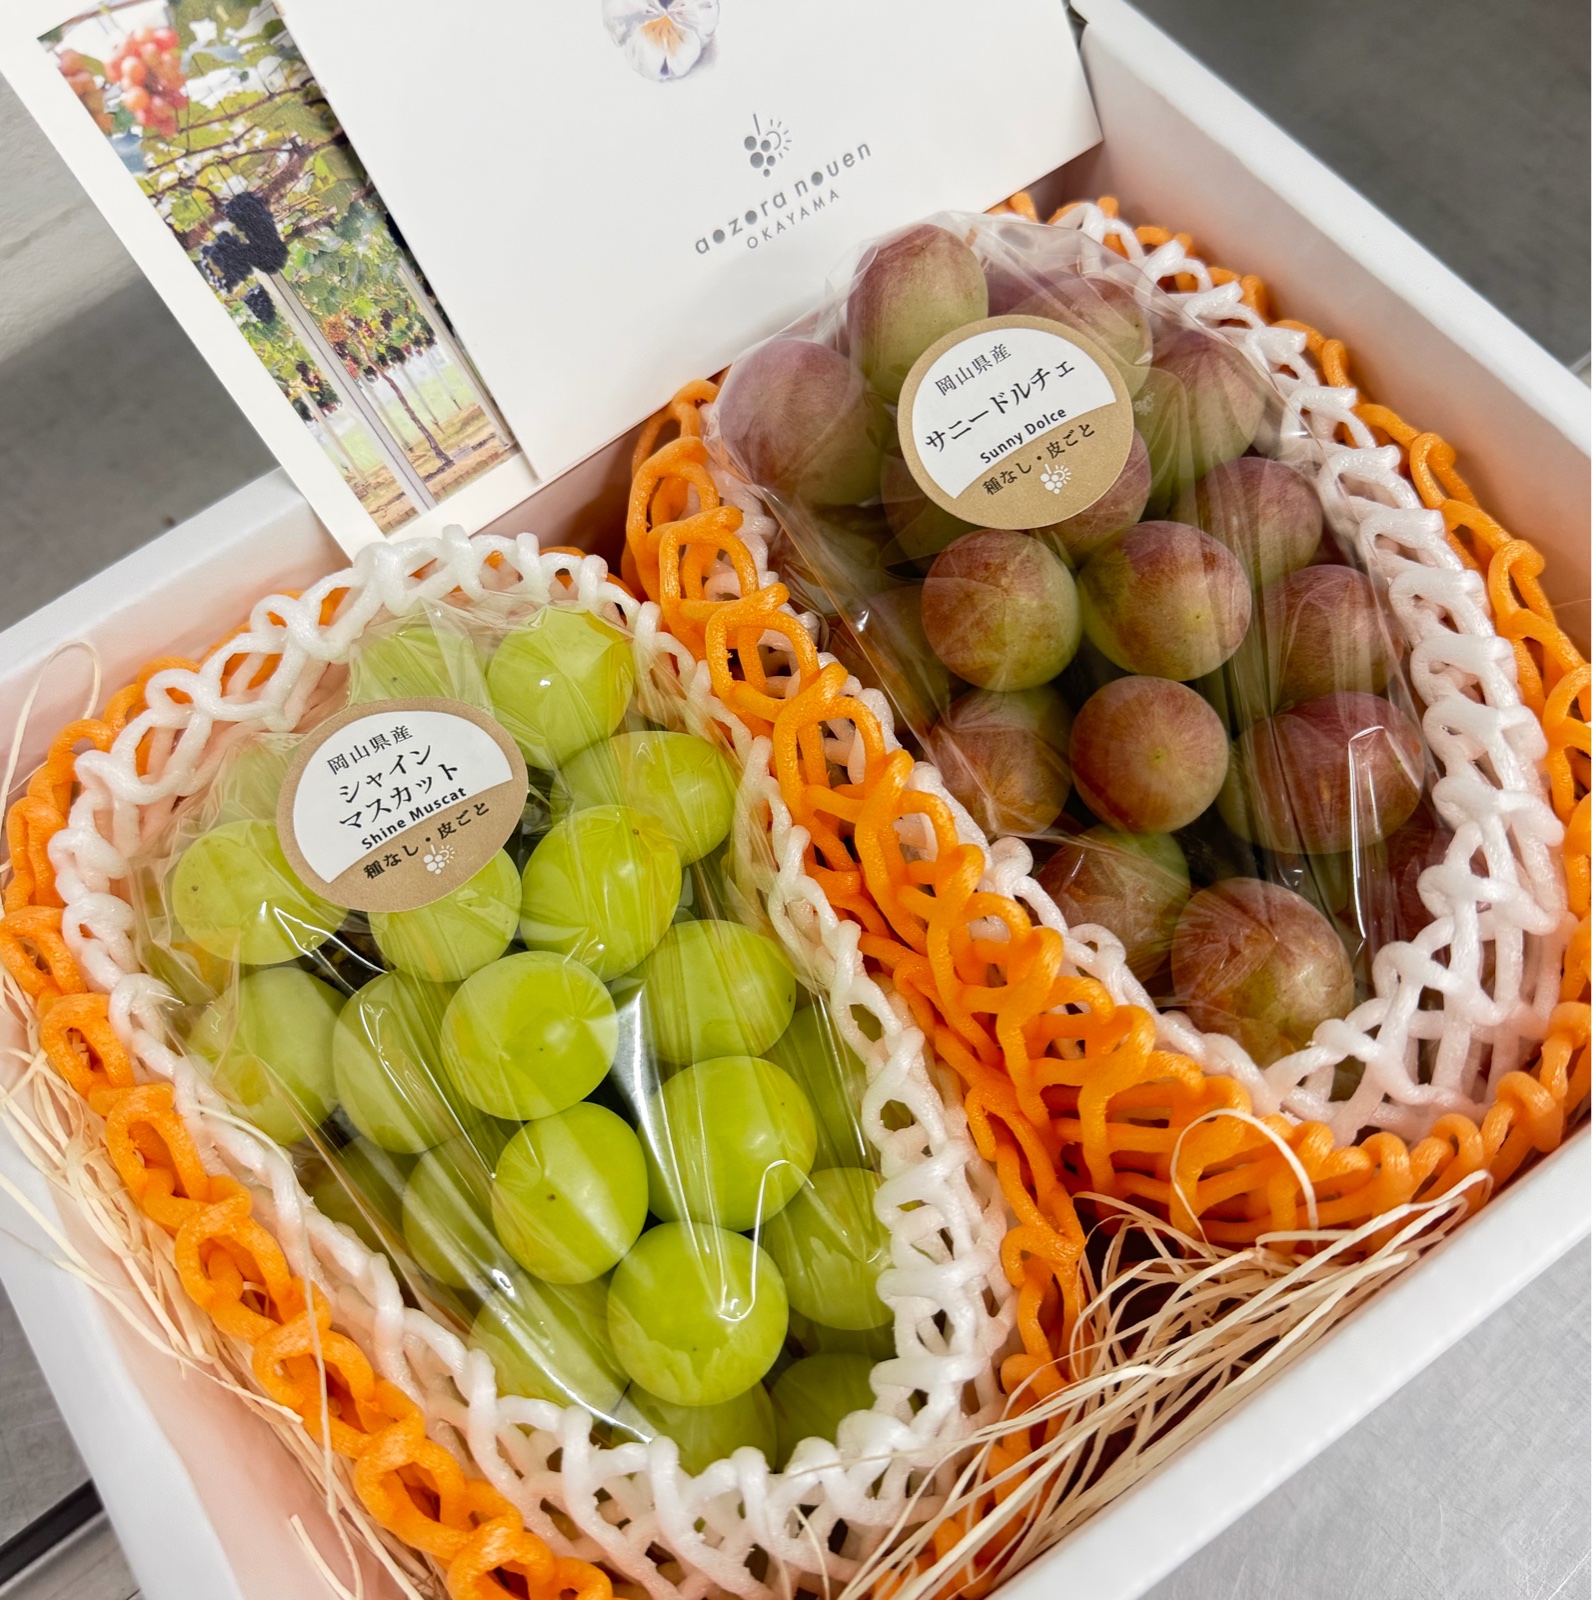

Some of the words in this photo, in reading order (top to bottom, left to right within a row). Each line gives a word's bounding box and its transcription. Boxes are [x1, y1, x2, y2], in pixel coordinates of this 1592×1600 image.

[695, 191, 787, 254] aozora
[794, 143, 871, 197] nouen
[747, 189, 839, 249] OKAYAMA
[935, 343, 1012, 395] 岡山県産
[925, 361, 1075, 452] サニードルチェ
[980, 432, 1024, 464] Sunny
[1024, 408, 1067, 435] Dolce
[982, 423, 1095, 495] 種なし・皮ごと
[327, 725, 413, 775] 岡山県産
[339, 745, 431, 803] シャイン
[339, 762, 458, 829] マスカット
[361, 818, 406, 850] Shine
[409, 787, 467, 822] Muscat
